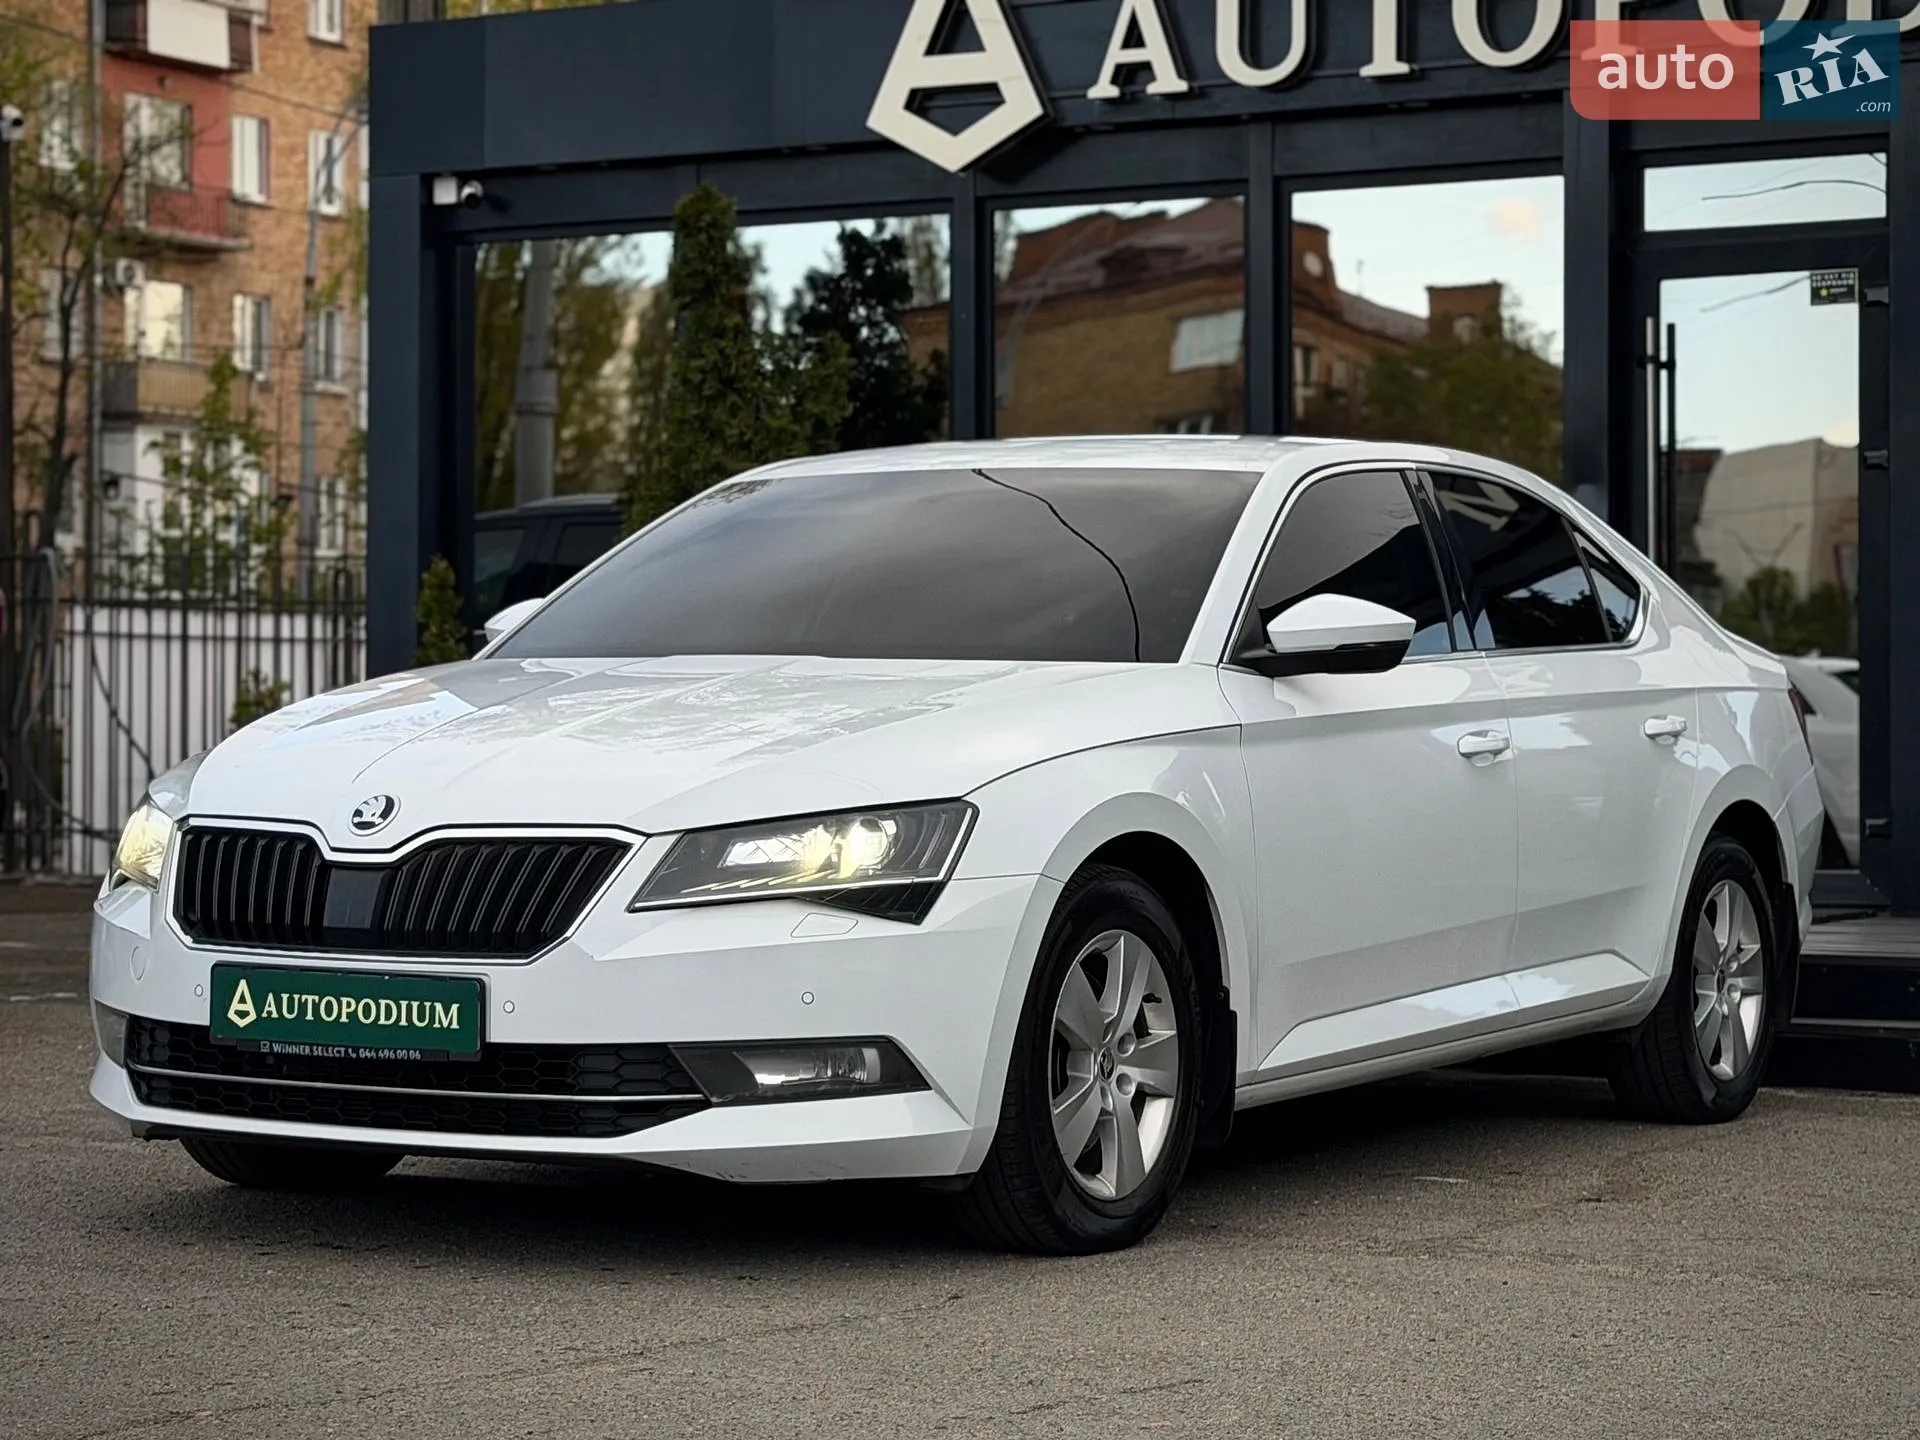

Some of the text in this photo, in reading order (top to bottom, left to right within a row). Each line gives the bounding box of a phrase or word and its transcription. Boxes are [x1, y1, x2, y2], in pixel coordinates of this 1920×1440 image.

[261, 992, 460, 1030] AUTOPODIUM
[312, 1045, 345, 1058] SELECT
[359, 1048, 376, 1059] 044
[378, 1049, 395, 1060] 496
[396, 1049, 408, 1061] 00
[409, 1050, 422, 1061] 06
